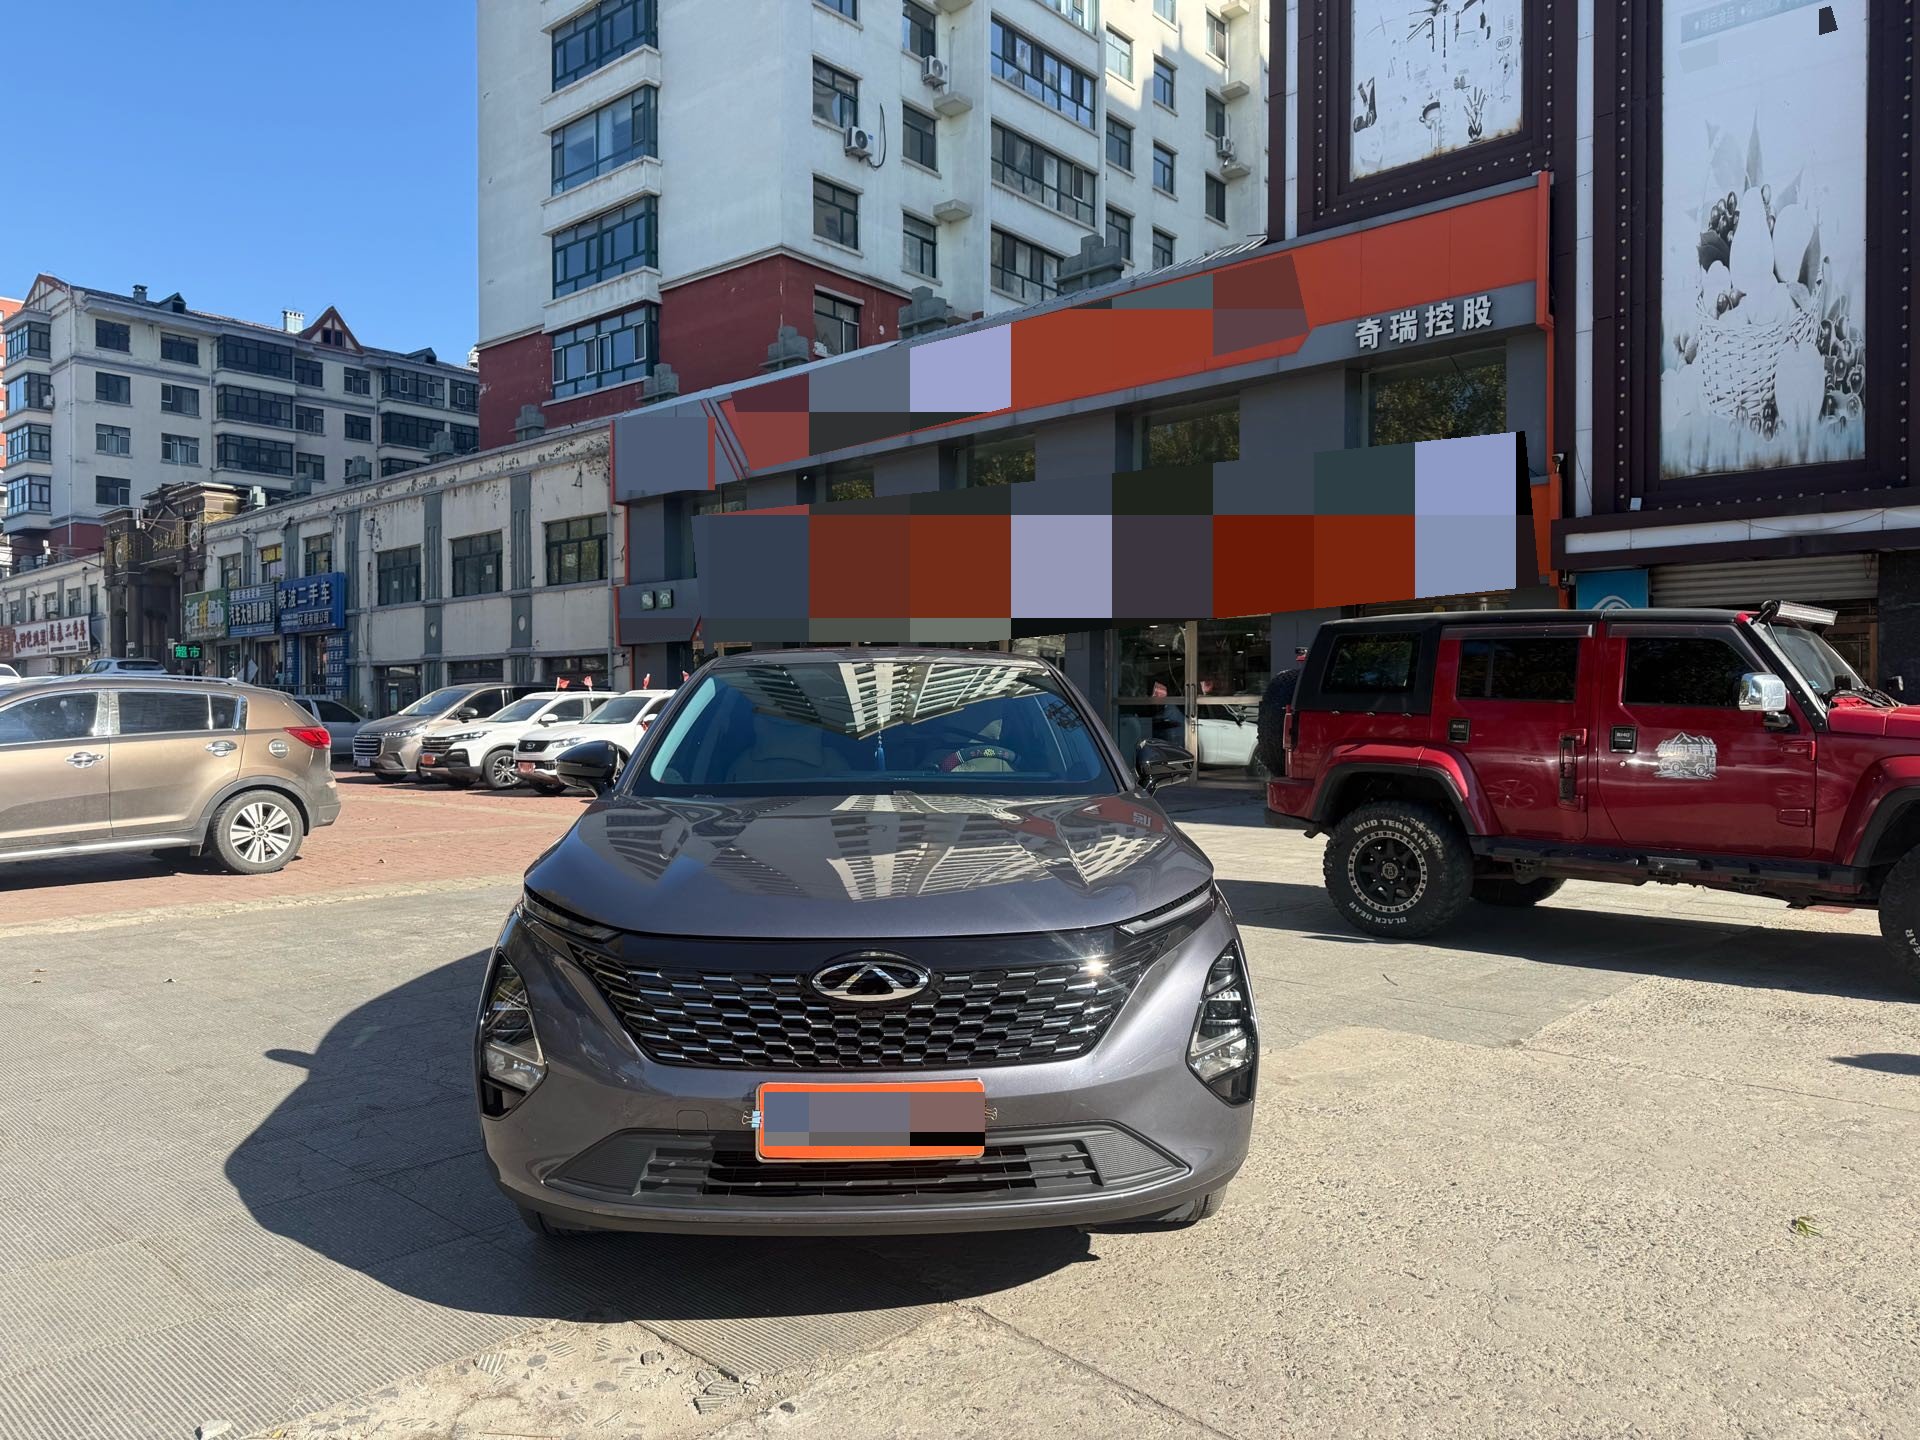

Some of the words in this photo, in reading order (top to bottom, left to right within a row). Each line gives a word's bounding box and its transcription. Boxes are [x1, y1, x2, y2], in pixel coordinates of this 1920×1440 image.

[1355, 295, 1492, 349] 奇瑞控股
[175, 645, 201, 658] 超市
[1353, 819, 1378, 834] MUD
[1382, 819, 1430, 852] TERRAIN
[1348, 901, 1373, 921] BEAR
[1374, 916, 1407, 925] BLACK
[1905, 928, 1920, 959] EAR
